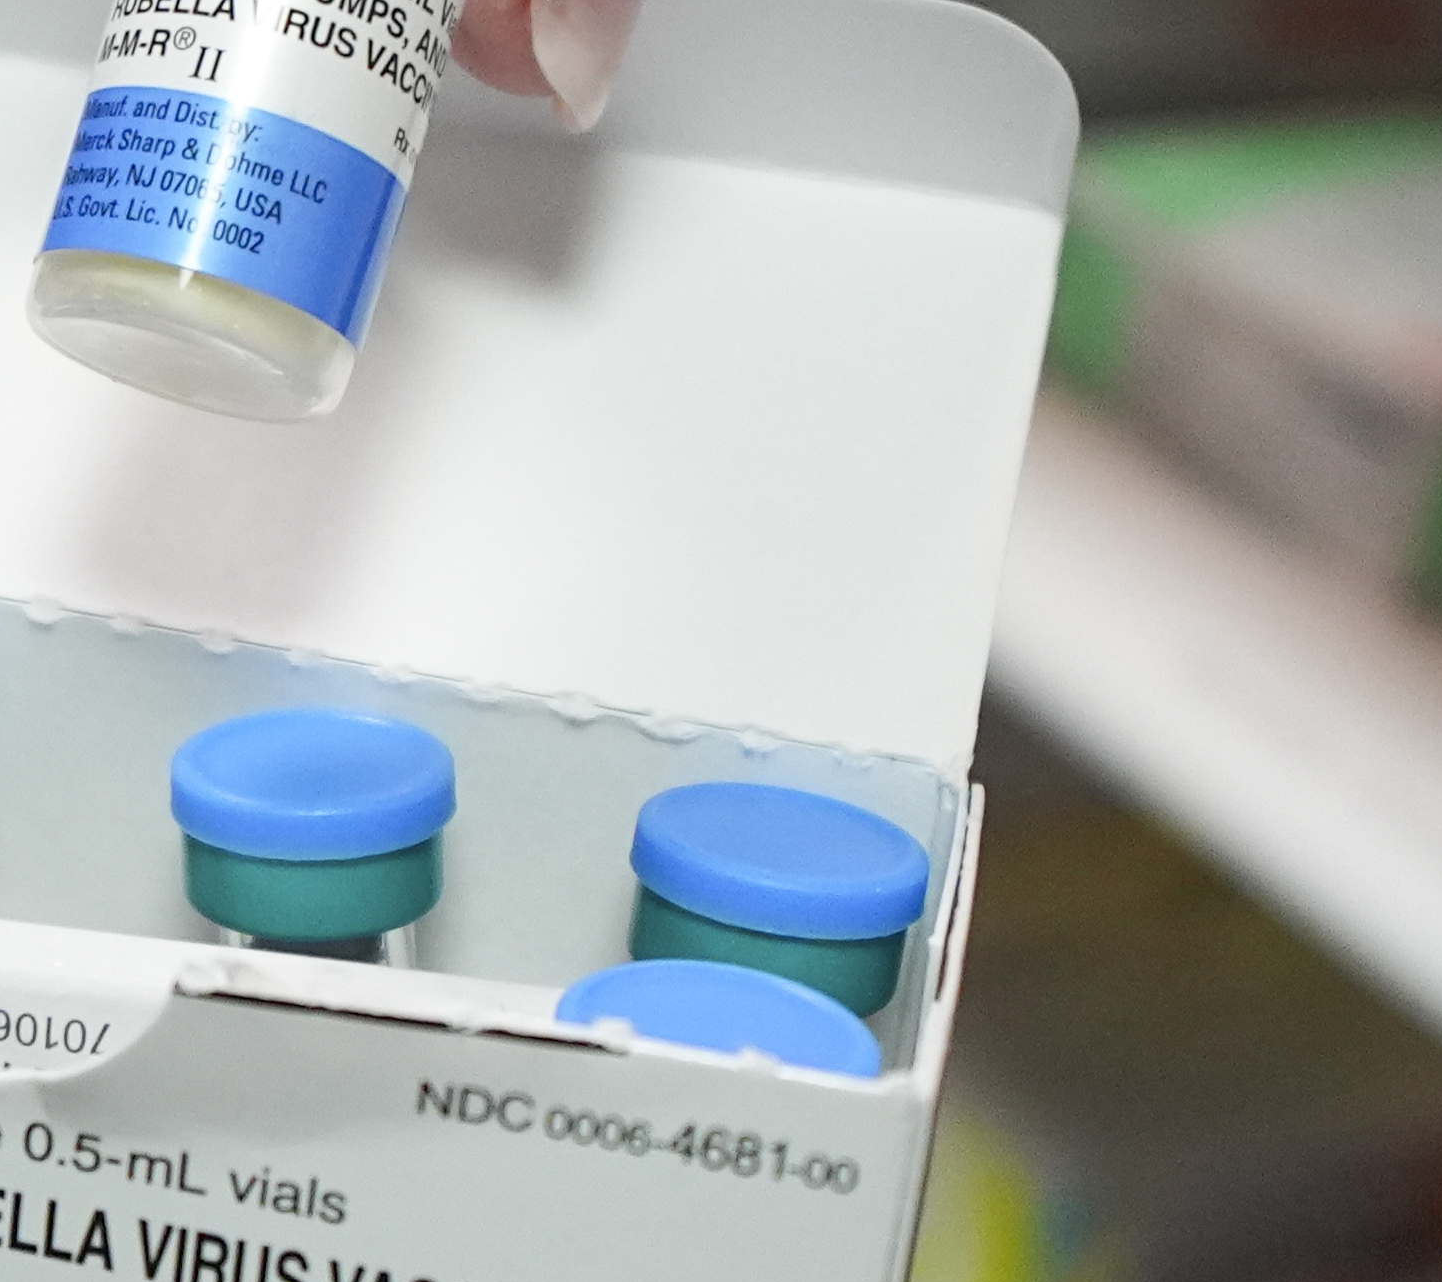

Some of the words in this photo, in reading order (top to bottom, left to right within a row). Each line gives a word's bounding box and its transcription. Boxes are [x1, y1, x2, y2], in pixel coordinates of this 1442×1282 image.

[98, 26, 197, 64] M-M-R®
[189, 46, 226, 81] II
[133, 99, 170, 120] and
[174, 101, 219, 131] Dist.
[228, 119, 264, 142] by:
[117, 128, 176, 160] Sharp
[181, 138, 198, 161] &
[289, 171, 328, 205] LLC
[127, 164, 155, 189] NJ
[235, 187, 283, 225] USA
[78, 195, 120, 218] Govt.
[125, 198, 161, 226] Lic.
[213, 219, 265, 255] 0002
[415, 1080, 537, 1133] NDC
[543, 1105, 861, 1196] 0006-4681-00
[23, 1121, 208, 1197] 0.5-mL
[229, 1166, 347, 1225] vials
